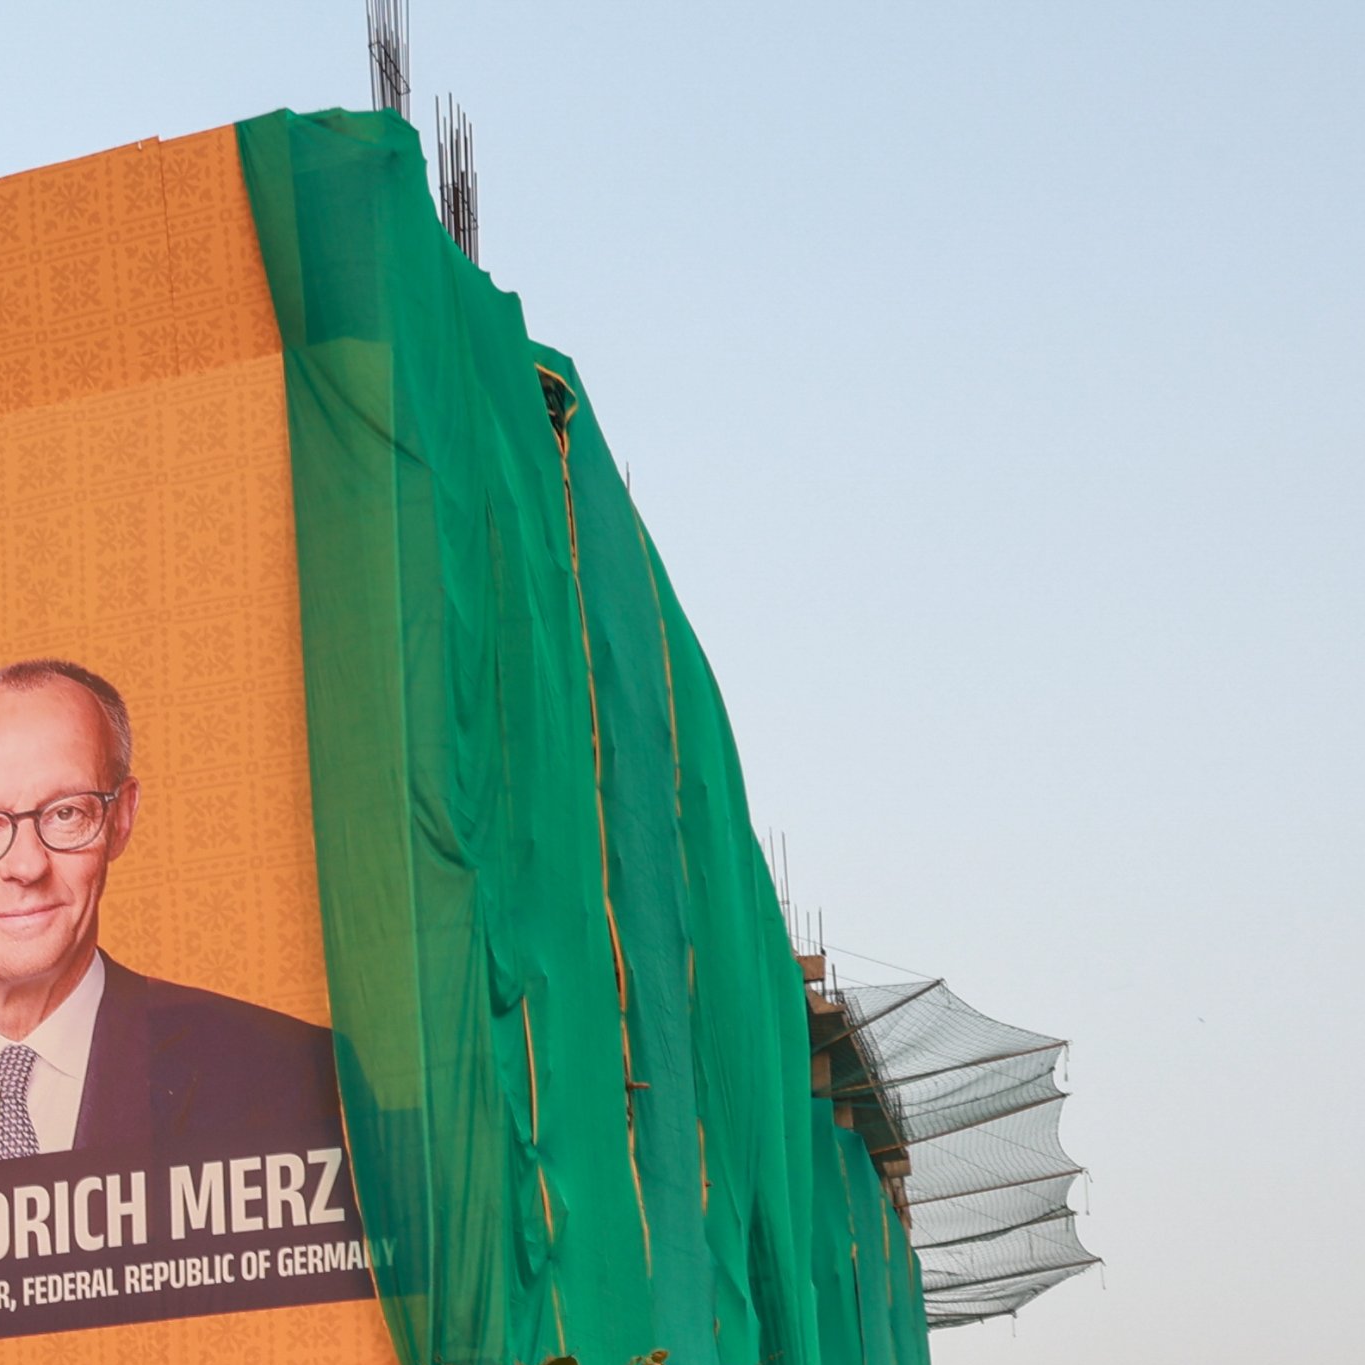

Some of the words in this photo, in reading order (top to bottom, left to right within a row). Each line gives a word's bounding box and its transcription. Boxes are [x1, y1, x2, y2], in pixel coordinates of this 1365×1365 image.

[170, 1147, 346, 1240] MERZ
[23, 1267, 119, 1307] FEDERAL
[125, 1253, 236, 1294] REPUBLIC
[241, 1250, 270, 1281] OF
